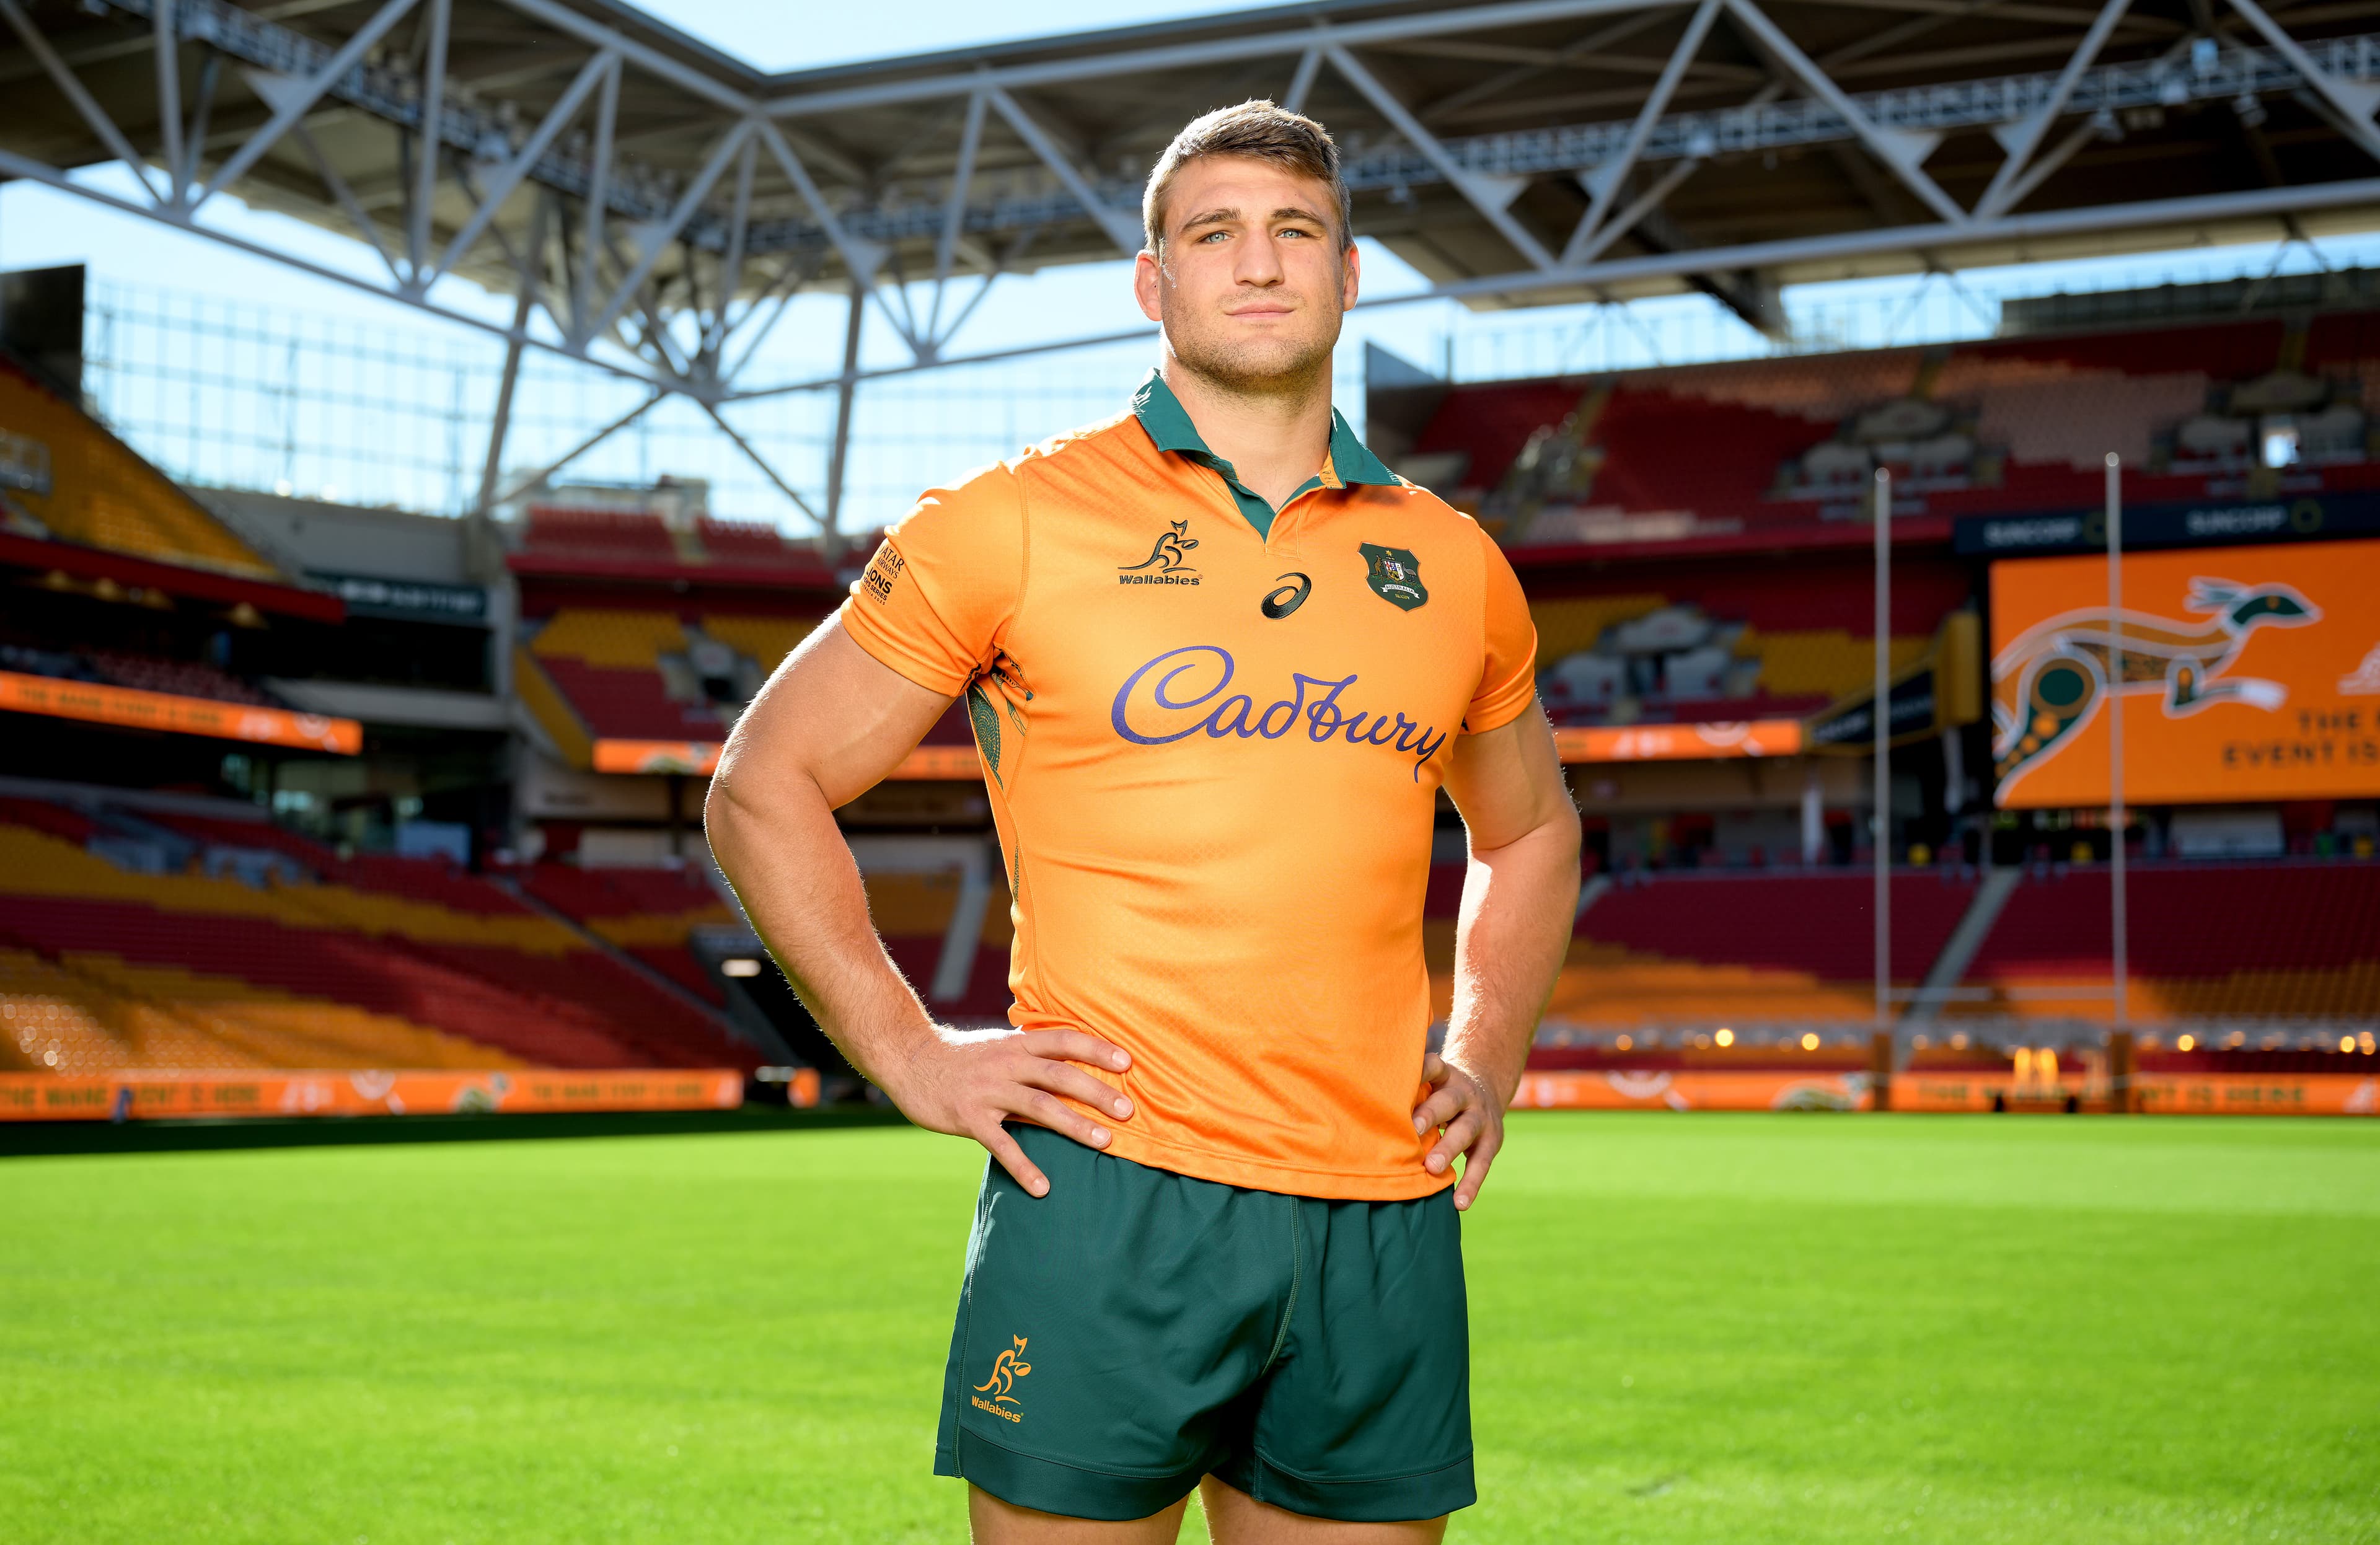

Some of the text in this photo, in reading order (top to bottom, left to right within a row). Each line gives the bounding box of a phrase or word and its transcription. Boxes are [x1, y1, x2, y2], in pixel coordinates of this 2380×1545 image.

[878, 545, 904, 571] ATAR
[871, 584, 888, 601] SERIES
[1119, 574, 1200, 586] Wallabies
[1385, 584, 1414, 594] AUSTRALIA
[1111, 645, 1447, 783] Cadbury
[2221, 738, 2335, 768] EVENT
[972, 1395, 1021, 1423] Wallabies
